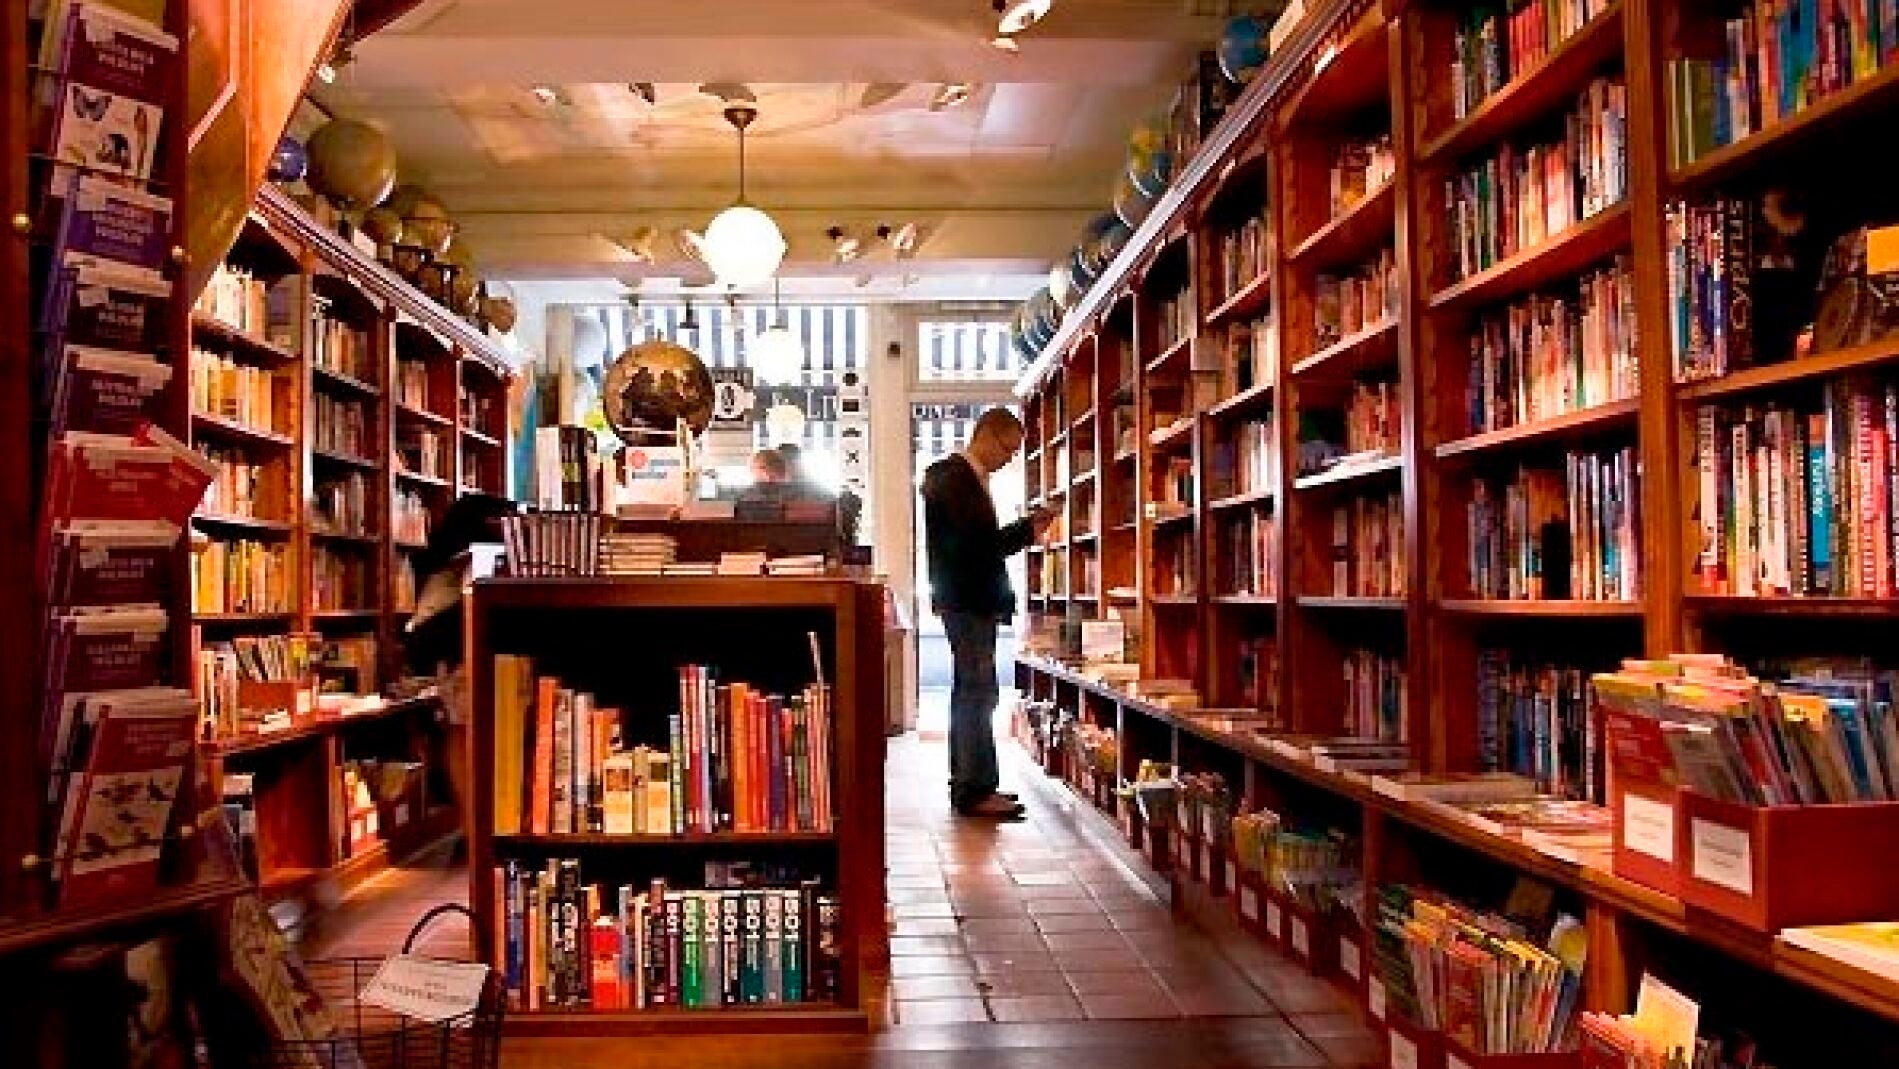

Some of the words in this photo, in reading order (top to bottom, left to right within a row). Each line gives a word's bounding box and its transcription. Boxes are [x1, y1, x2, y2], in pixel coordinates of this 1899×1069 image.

[1729, 200, 1750, 329] CYPRUS
[1812, 455, 1826, 518] Turkey
[724, 899, 738, 942] 501
[746, 900, 760, 939] 501
[784, 899, 799, 941] 501
